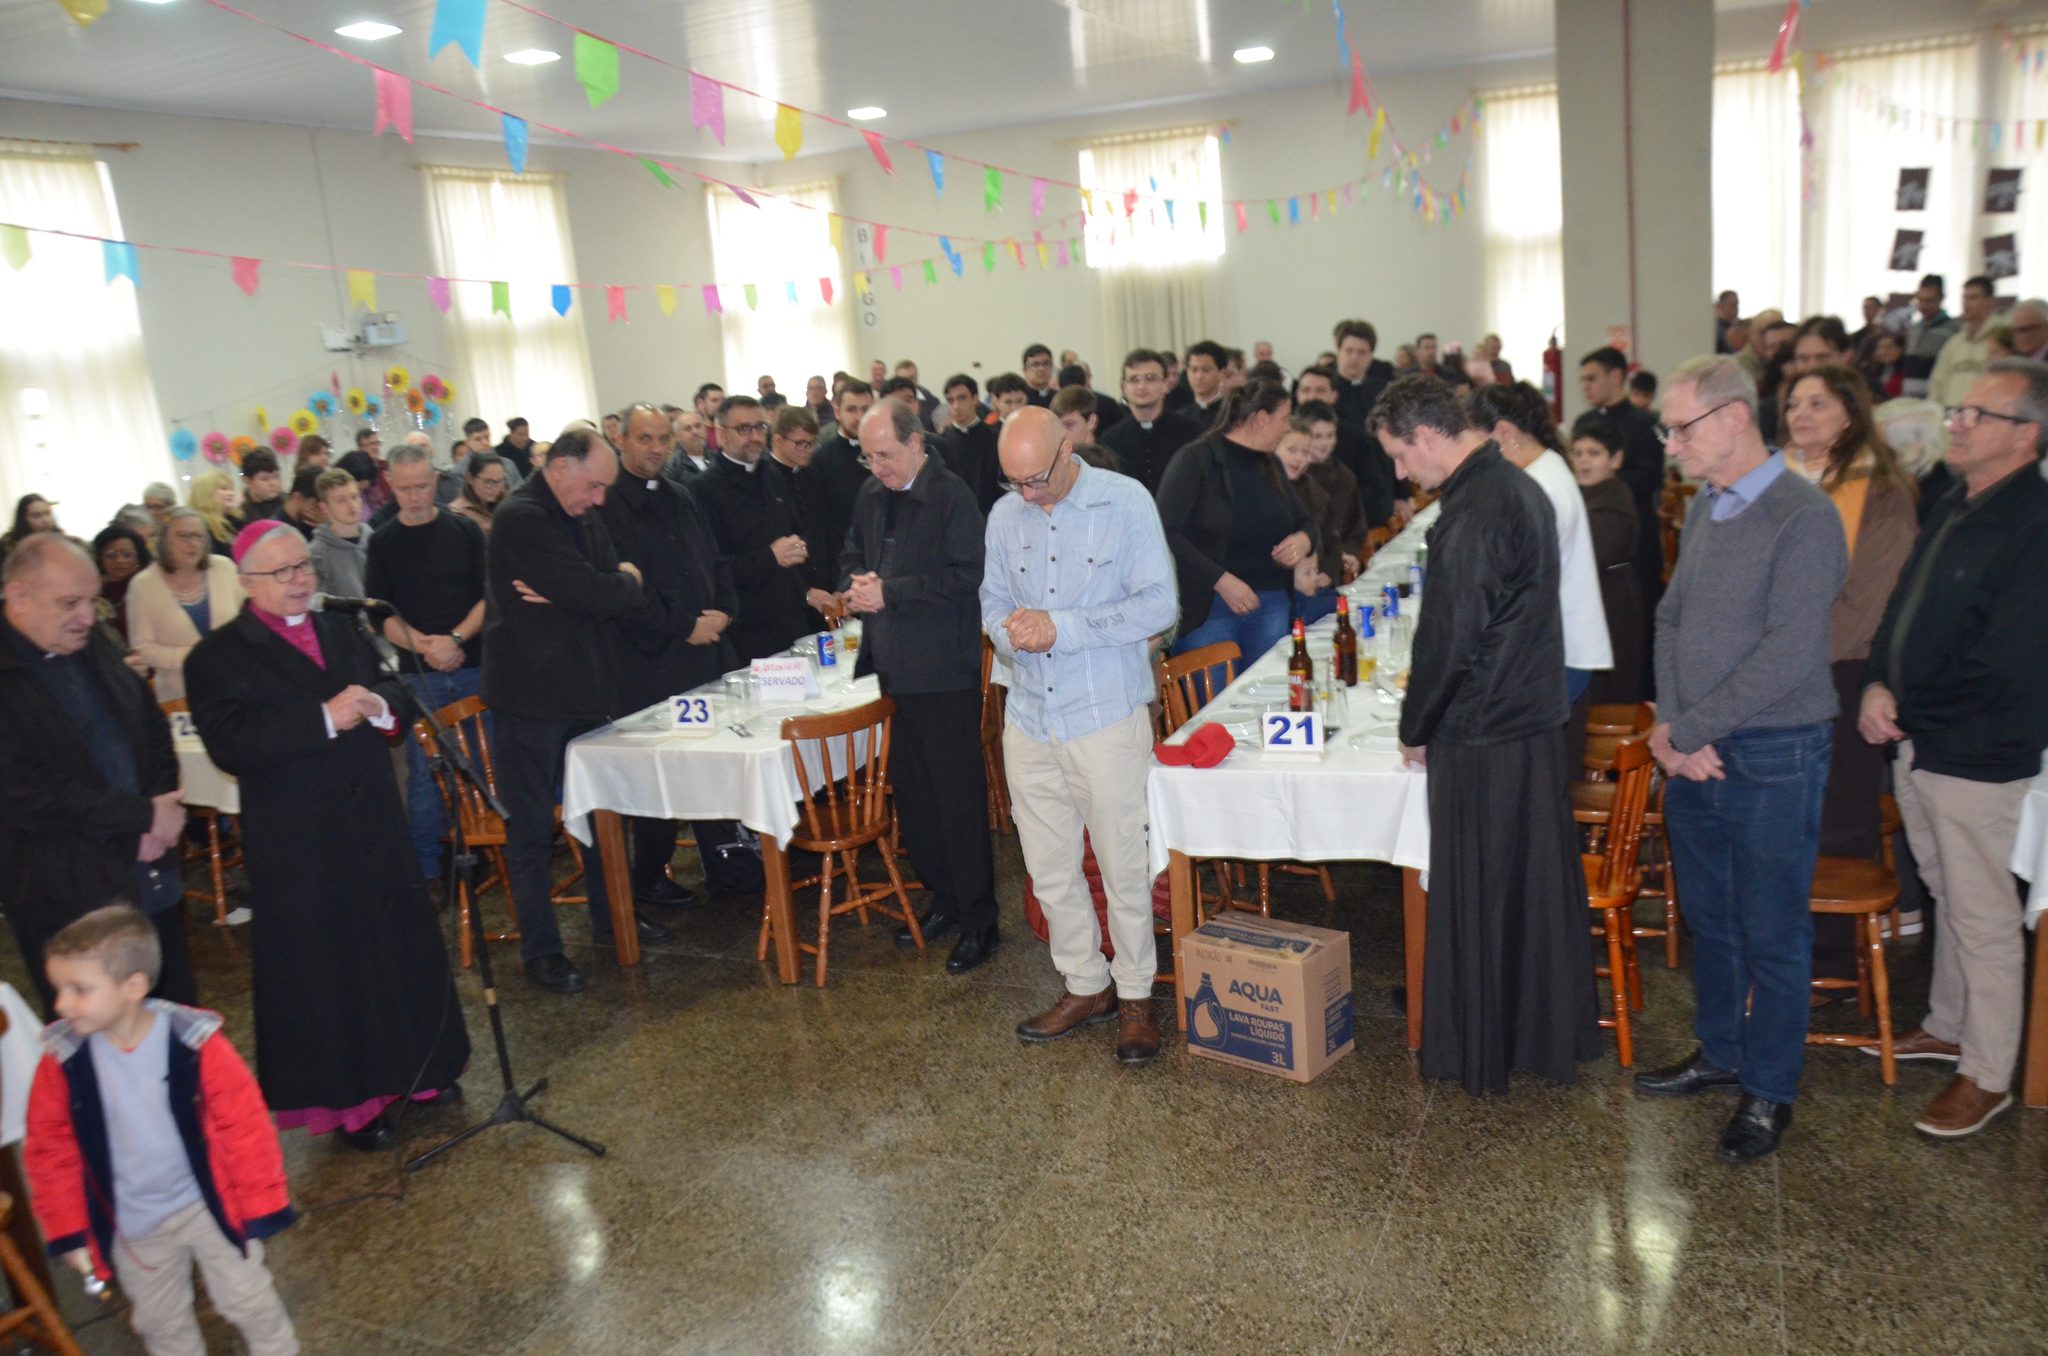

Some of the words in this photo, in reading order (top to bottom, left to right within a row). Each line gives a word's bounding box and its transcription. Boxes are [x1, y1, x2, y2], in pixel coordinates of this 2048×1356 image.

[675, 698, 709, 724] 23
[1268, 715, 1314, 745] 21
[1229, 979, 1283, 1004] AQUA
[1260, 1003, 1280, 1012] FAST
[1228, 1011, 1250, 1025] LAVA
[1250, 1017, 1285, 1032] ROUPAS
[1271, 1051, 1287, 1066] 3L
